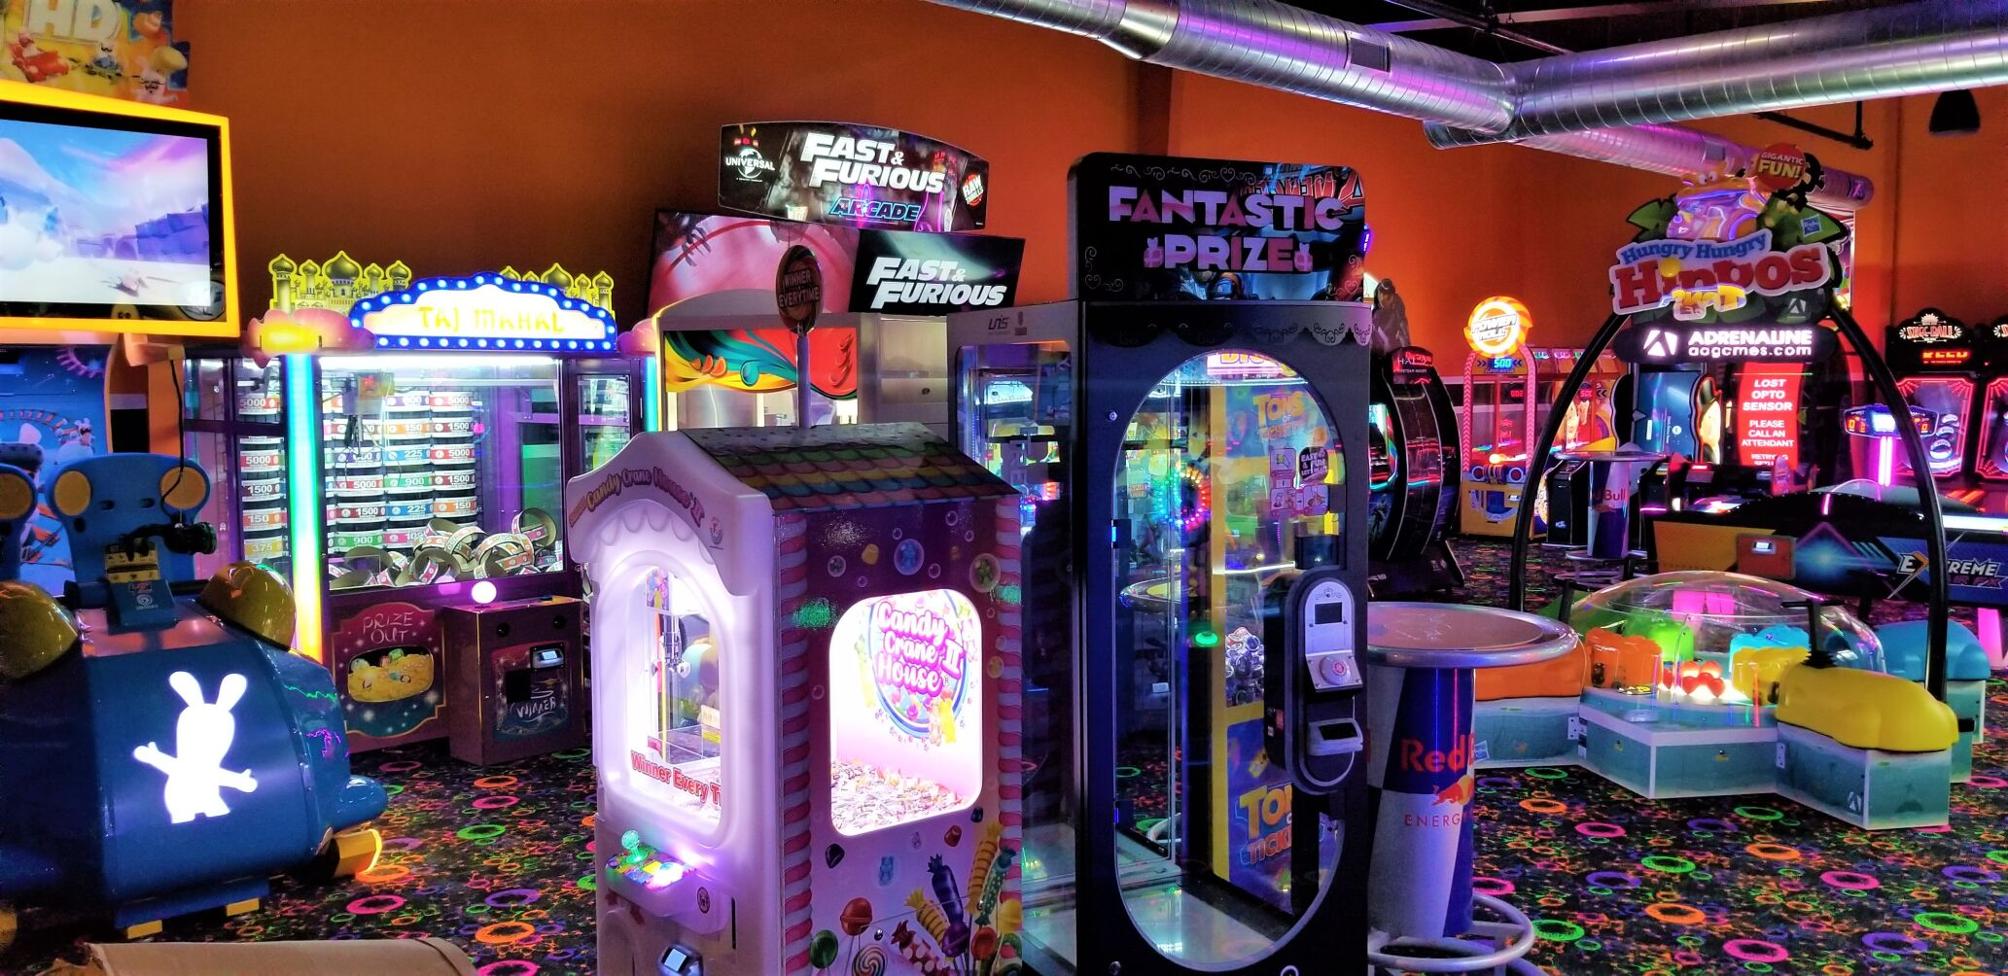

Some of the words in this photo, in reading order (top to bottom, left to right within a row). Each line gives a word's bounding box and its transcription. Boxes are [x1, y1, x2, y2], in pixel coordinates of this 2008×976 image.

[800, 132, 896, 164] FAST
[890, 151, 906, 167] &
[725, 156, 776, 171] UNIVERSAL
[1761, 152, 1804, 164] GIGANTIC
[1758, 160, 1801, 178] FUN!
[808, 158, 946, 194] FURIOUS
[830, 198, 922, 222] ARCADE
[1109, 186, 1346, 231] FANTASTIC
[1164, 234, 1294, 272] PRIZE
[1621, 243, 1694, 265] Hungry
[1695, 234, 1768, 259] Hungry
[866, 256, 959, 285] FAST
[950, 268, 967, 282] &
[784, 269, 812, 287] WINNER
[870, 280, 1008, 309] FURIOUS
[1688, 330, 1813, 345] ADRENALINE
[1754, 379, 1787, 388] LOST
[1751, 390, 1786, 399] OPTO
[1743, 402, 1793, 411] SENSOR
[447, 423, 469, 431] 1500
[1749, 420, 1785, 428] PLEASE
[1748, 430, 1771, 438] CALL
[1772, 430, 1786, 438] AN
[1741, 439, 1794, 447] ATTENDANT
[404, 449, 423, 458] 225
[448, 449, 469, 457] 5000
[246, 455, 272, 465] 5000
[353, 480, 376, 489] 5000
[404, 477, 424, 486] 900
[447, 475, 470, 484] 1500
[248, 484, 273, 494] 1500
[587, 475, 622, 512] Candy
[622, 468, 652, 487] Crane
[355, 507, 379, 516] 1500
[407, 504, 427, 513] 225
[247, 515, 269, 524] 150
[353, 535, 373, 545] 900
[362, 611, 414, 635] PRIZE
[878, 601, 949, 647] Candy
[370, 629, 409, 645] OUT
[883, 630, 937, 669] Crane
[877, 651, 943, 697] House
[631, 749, 672, 785] Winner
[673, 766, 710, 804] Every
